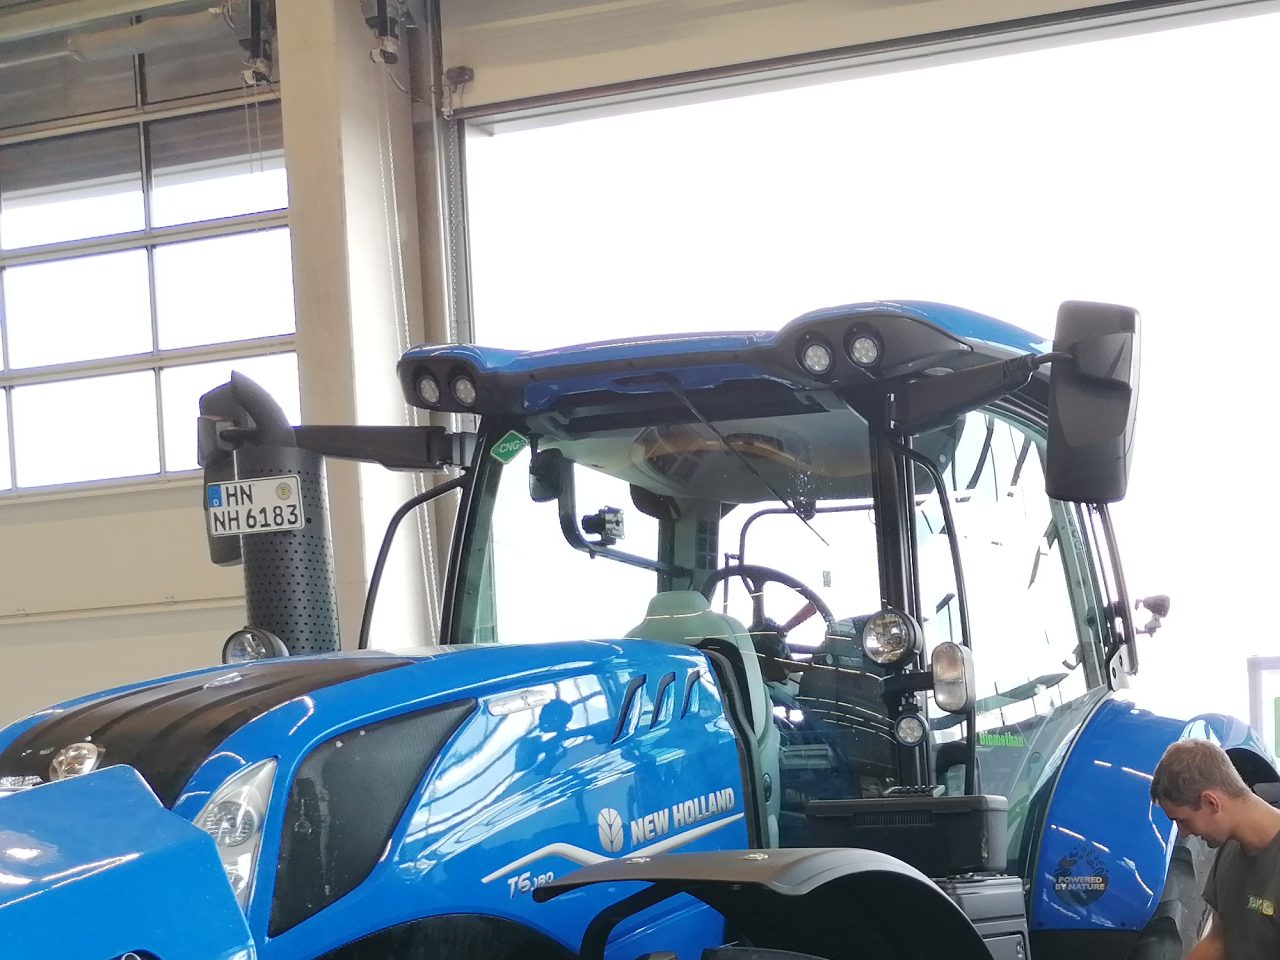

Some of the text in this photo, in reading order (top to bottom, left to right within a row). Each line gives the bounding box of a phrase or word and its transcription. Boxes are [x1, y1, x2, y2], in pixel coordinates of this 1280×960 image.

[499, 439, 521, 454] CNG
[225, 484, 254, 507] HN
[213, 503, 299, 532] NH 6183
[979, 730, 1024, 748] Biomethan
[630, 787, 735, 847] NEW HOLLAND
[1055, 883, 1067, 891] BY
[1058, 876, 1103, 884] POWERED
